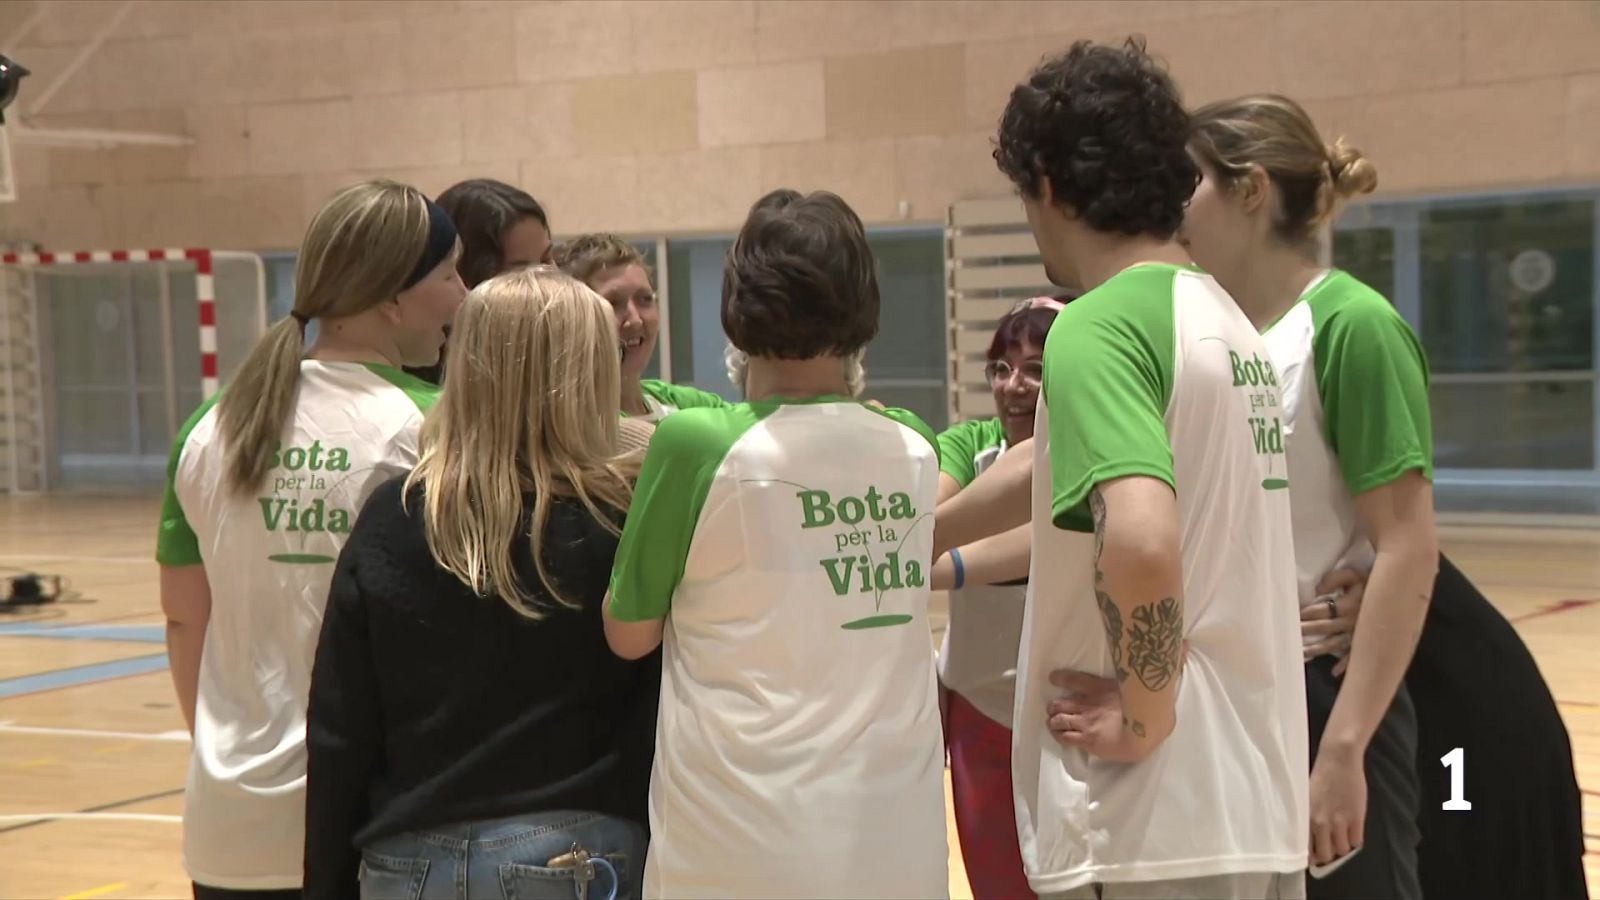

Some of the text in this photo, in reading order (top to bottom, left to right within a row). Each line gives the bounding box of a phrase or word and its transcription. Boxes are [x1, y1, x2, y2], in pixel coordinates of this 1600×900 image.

[1229, 350, 1277, 387] Bota
[1249, 389, 1278, 413] per la
[1248, 417, 1284, 454] Vid
[274, 474, 326, 493] per la
[258, 497, 352, 533] Vida
[796, 485, 916, 529] Bota
[834, 524, 898, 551] per la
[819, 551, 925, 596] Vida
